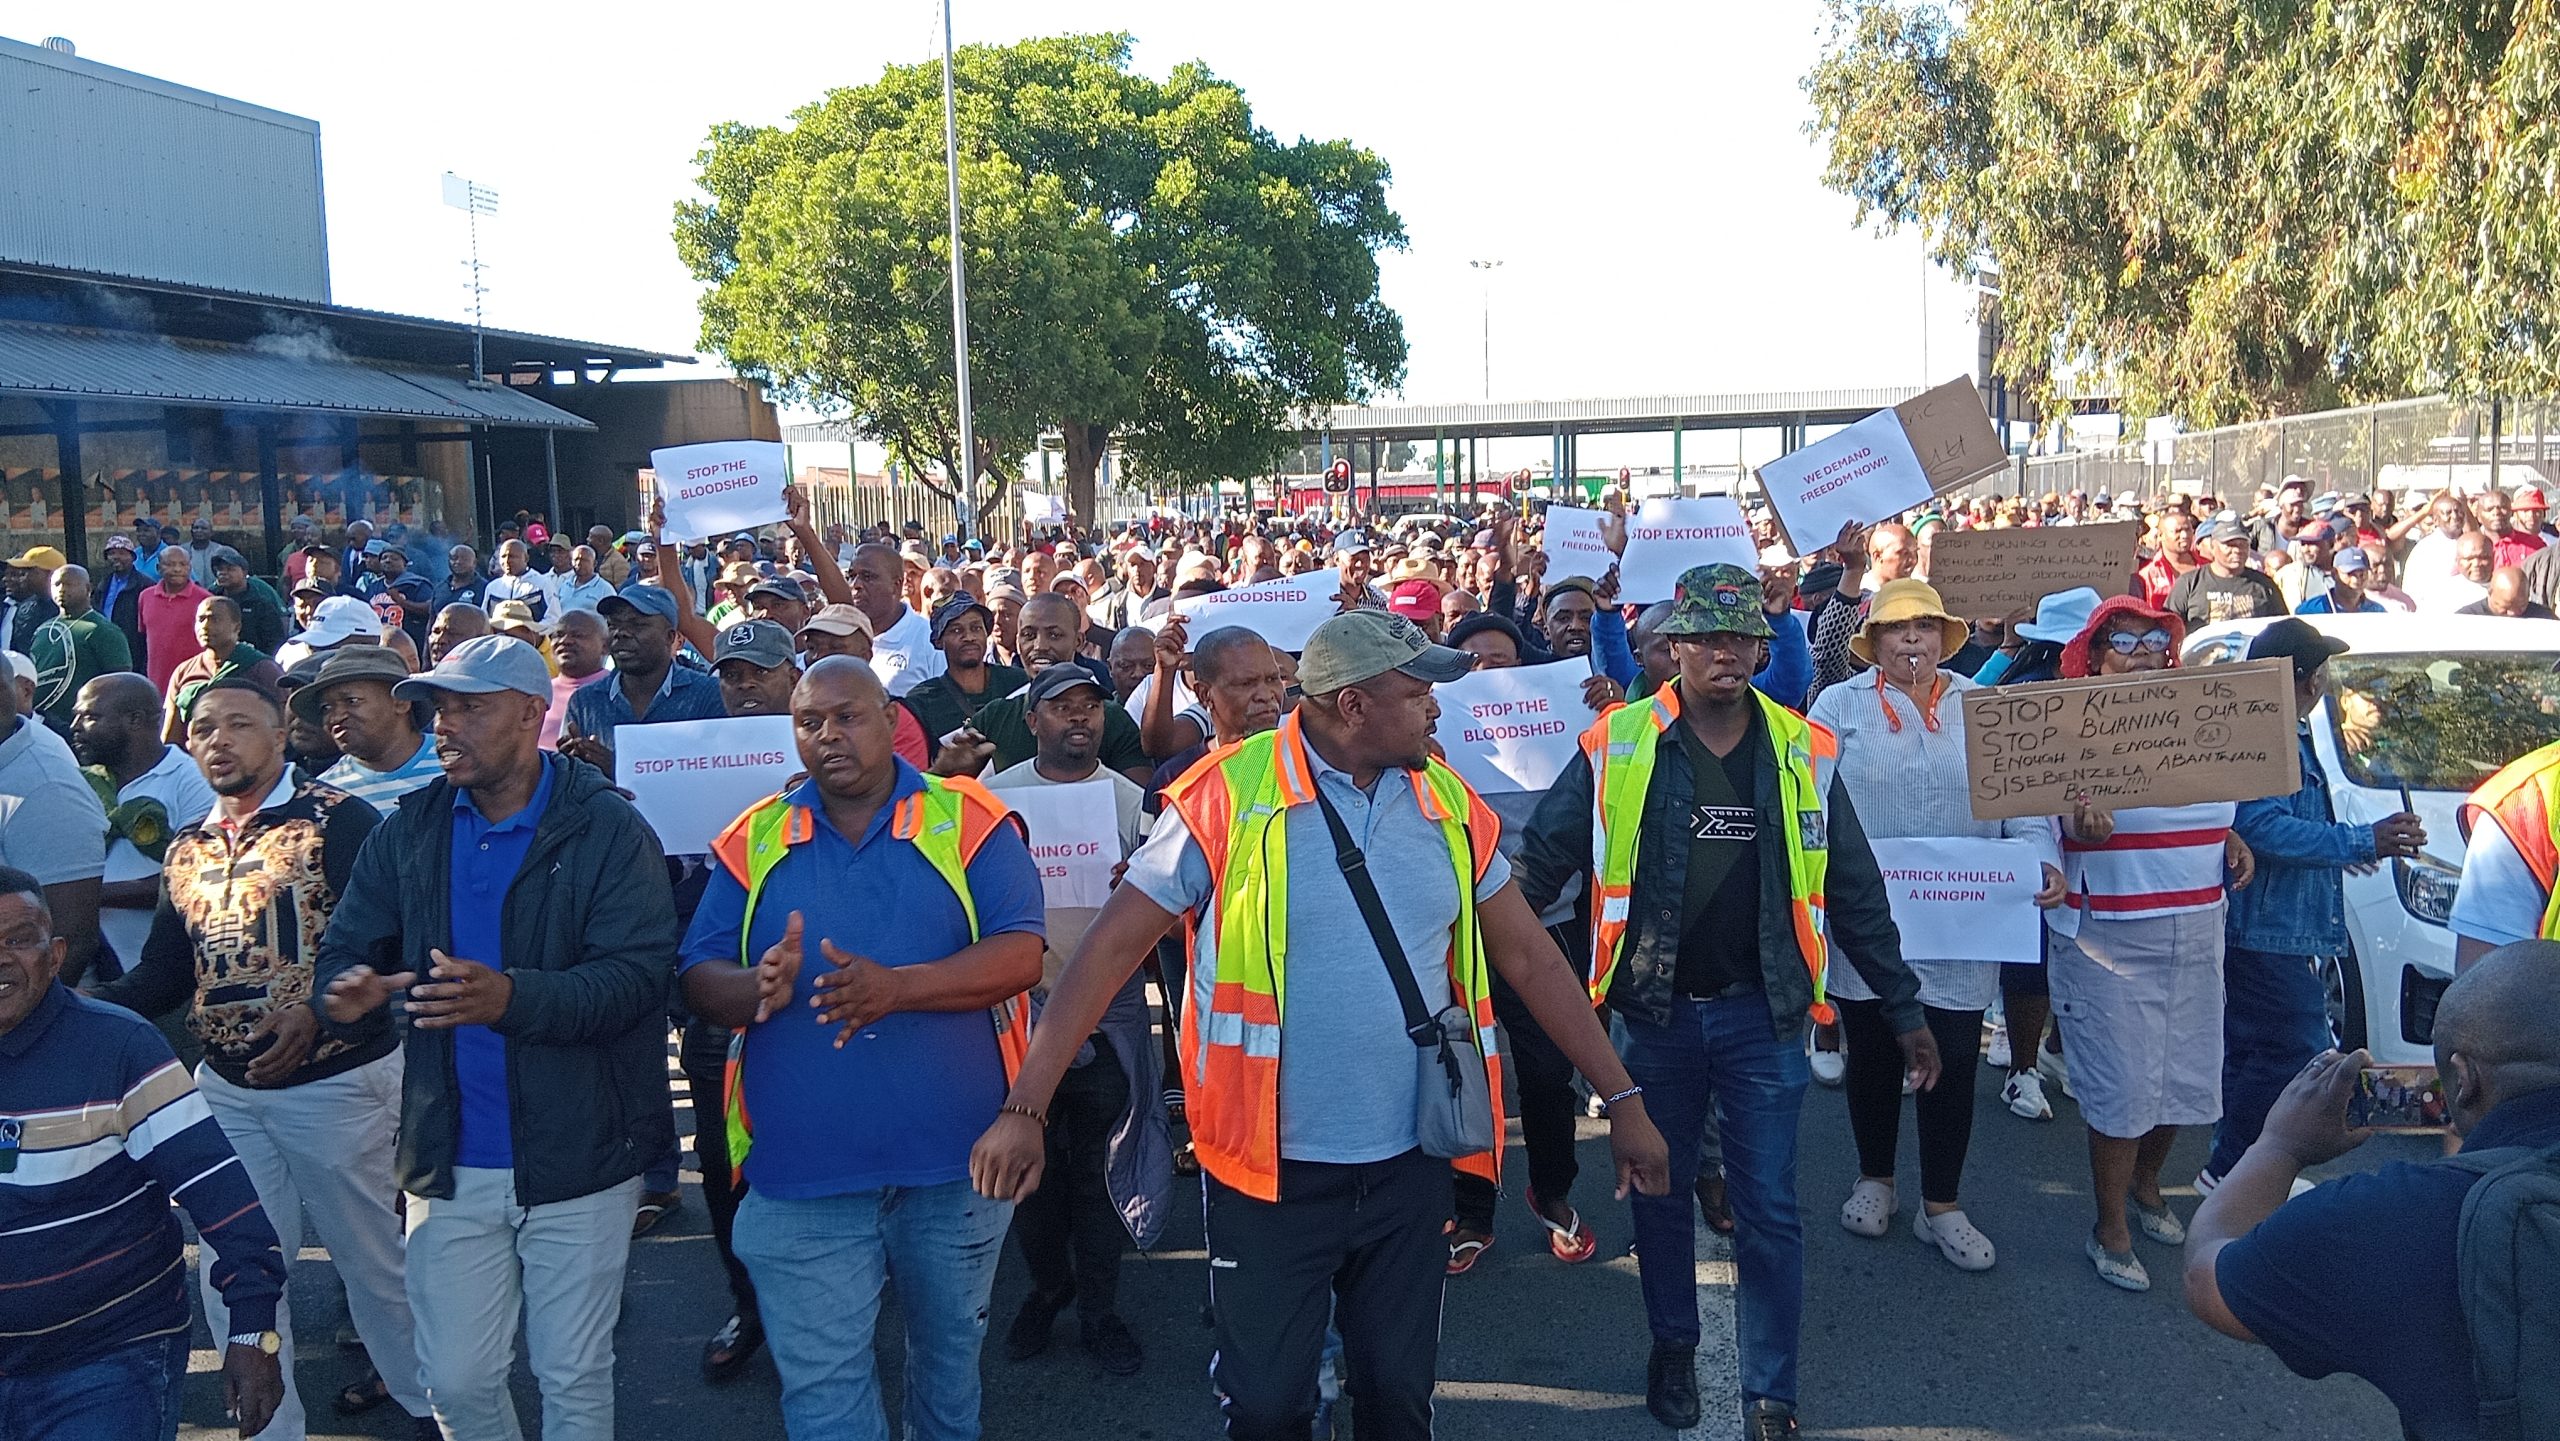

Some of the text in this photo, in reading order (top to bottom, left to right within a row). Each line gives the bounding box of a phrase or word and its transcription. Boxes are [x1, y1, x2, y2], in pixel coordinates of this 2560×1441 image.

[687, 460, 747, 480] STOP THE
[1803, 447, 1871, 484] WE DEMAND
[680, 475, 759, 500] BLOODSHED
[1800, 455, 1889, 504] FREEDOM NOW!!
[1572, 529, 1587, 539] WE
[1631, 525, 1745, 541] STOP EXTORTION
[1561, 540, 1605, 553] FREEDOM
[1935, 538, 2093, 550] STOP BURNING OUR
[1209, 590, 1307, 604] BLOODSHED
[1472, 699, 1549, 718] STOP THE
[1975, 681, 2237, 728] STOP KILLING US
[1463, 720, 1566, 743] BLOODSHED
[1982, 726, 2058, 757] STOP
[2078, 708, 2180, 739] BURNING
[2194, 703, 2238, 721] OUR
[635, 751, 785, 774] STOP THE KILLINGS
[1993, 736, 2187, 773] ENOUGH IS ENOUGH
[1977, 751, 2267, 801] SISEBENZELA ABANTWANA
[1077, 842, 1099, 856] OF
[1883, 869, 2015, 883] PATRICK KHULELA
[1909, 889, 1986, 901] A KINGPIN
